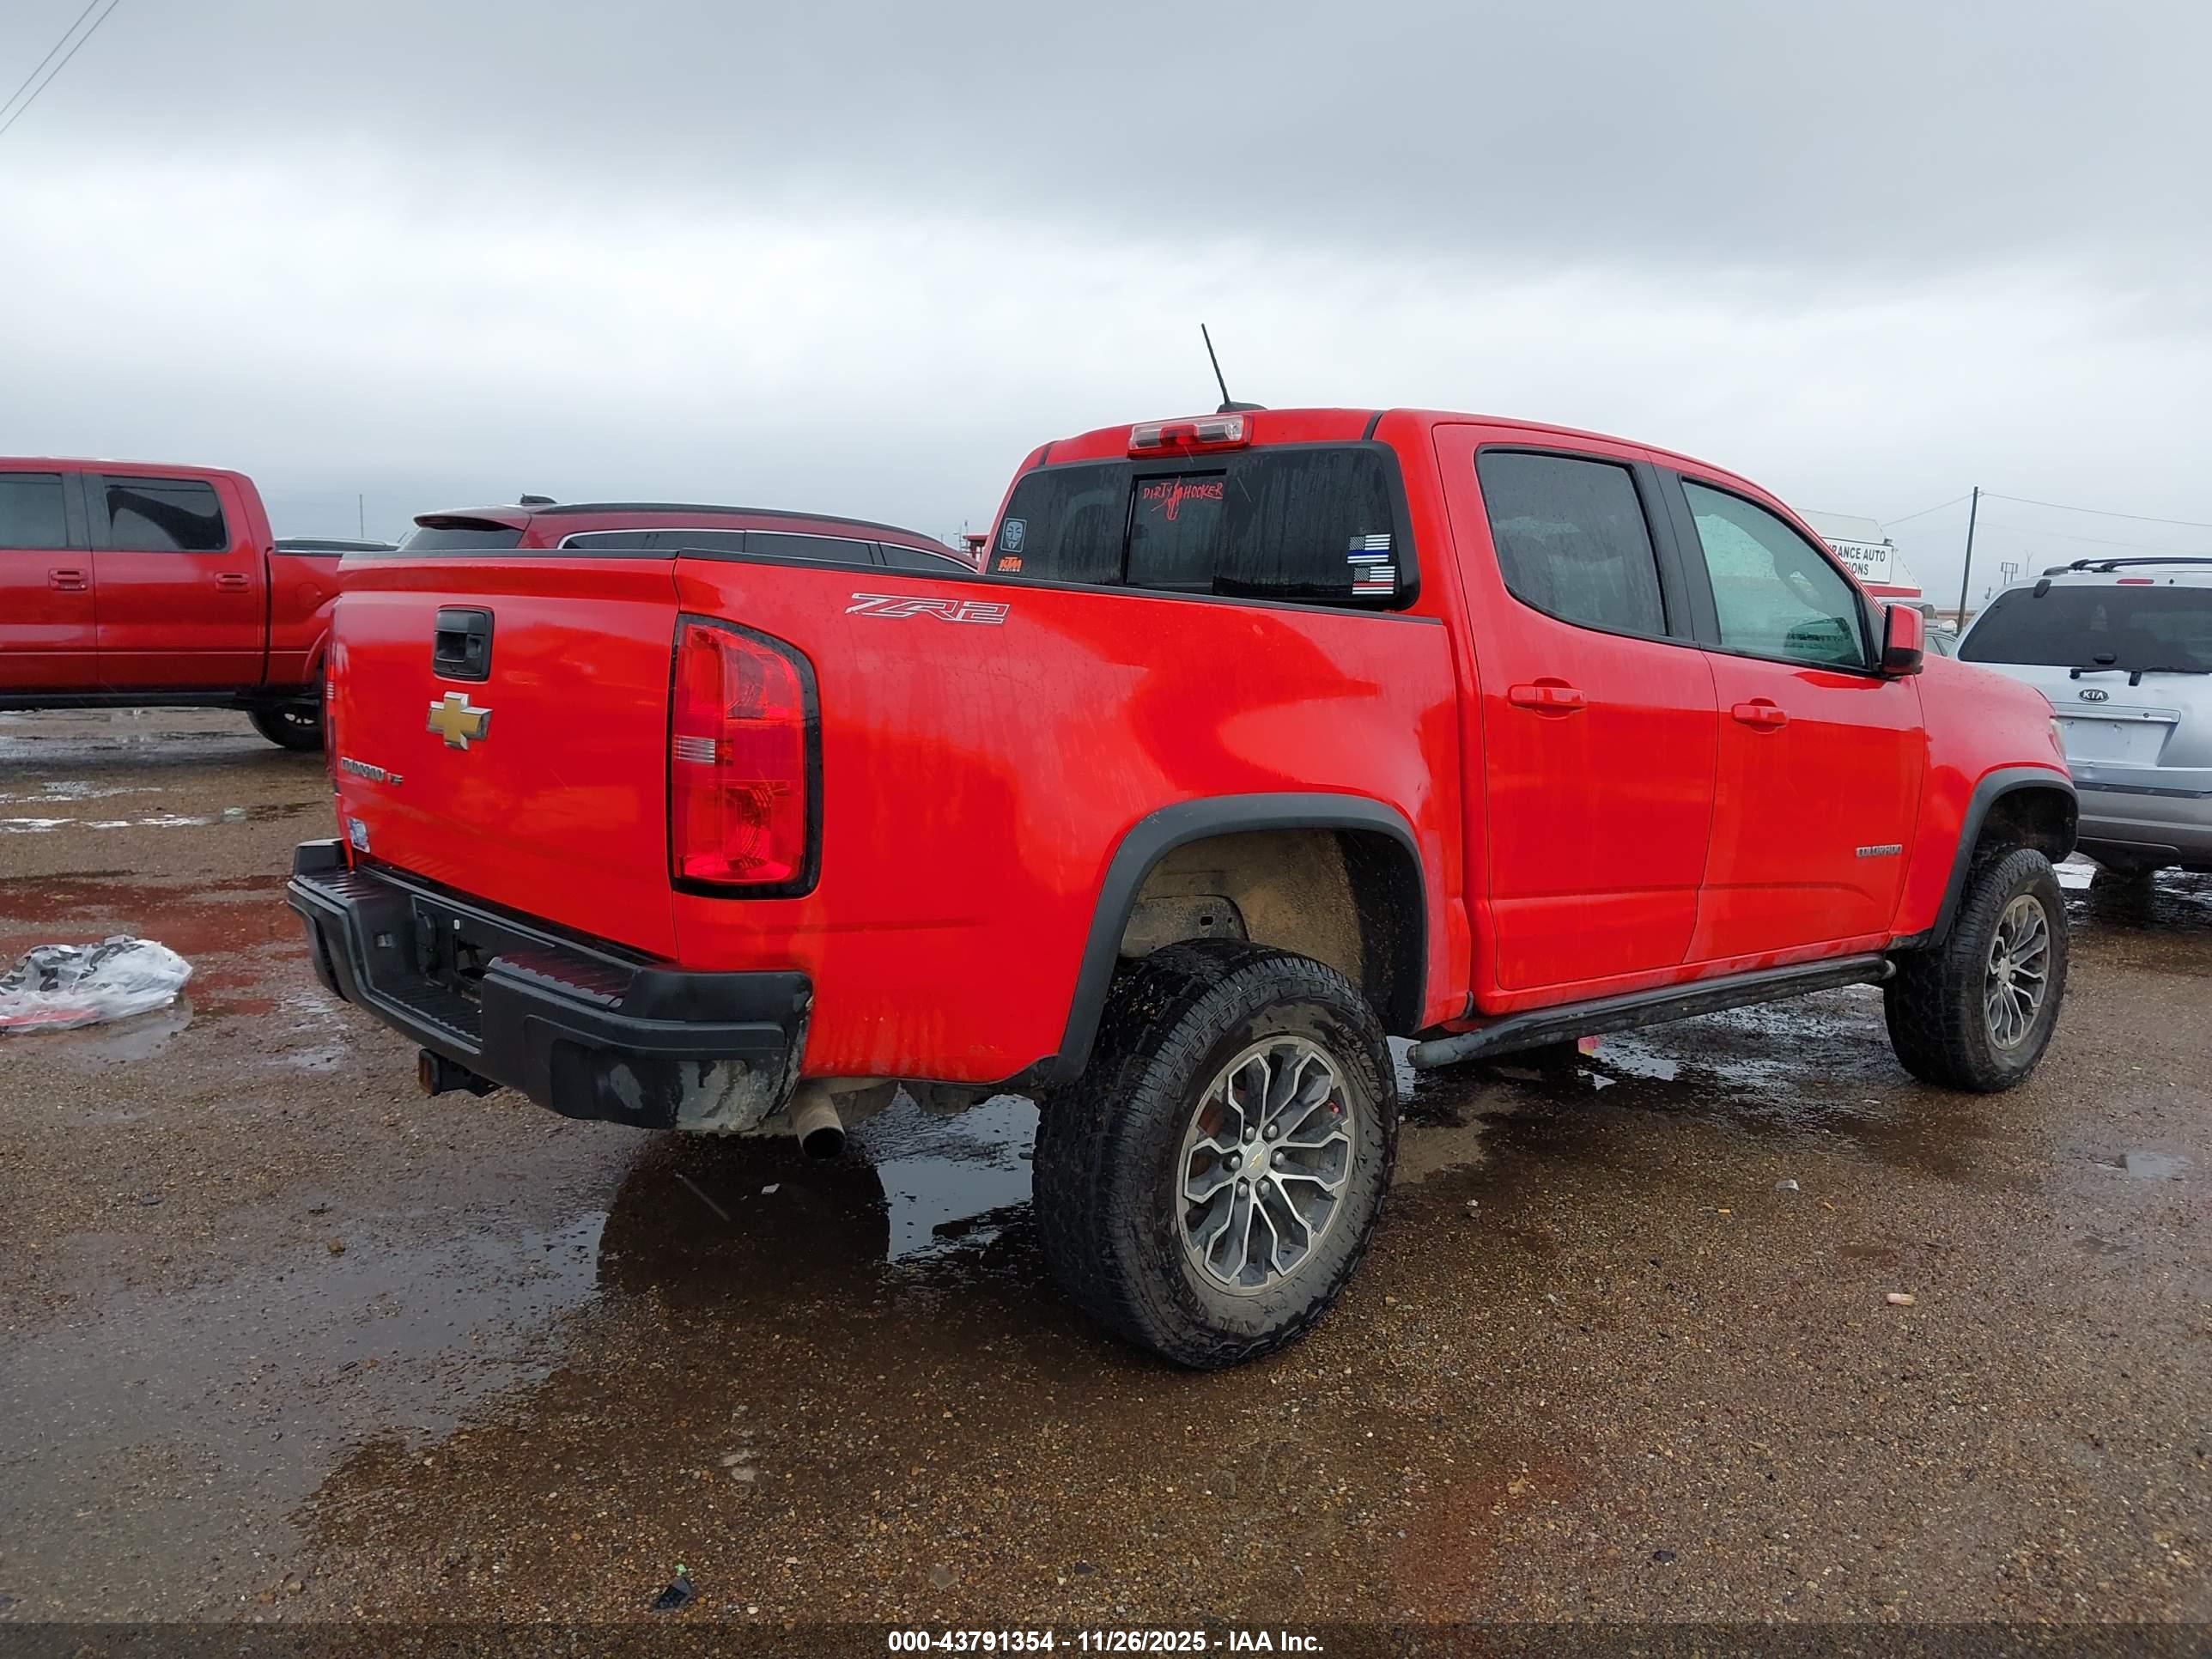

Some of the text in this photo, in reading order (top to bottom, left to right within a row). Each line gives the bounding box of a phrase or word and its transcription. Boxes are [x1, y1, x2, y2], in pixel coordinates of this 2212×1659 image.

[1142, 481, 1224, 500] DIRTY HOOKER
[1828, 544, 1887, 562] RANCE AUTO
[999, 556, 1023, 569] KTM
[844, 592, 1012, 625] ZR2
